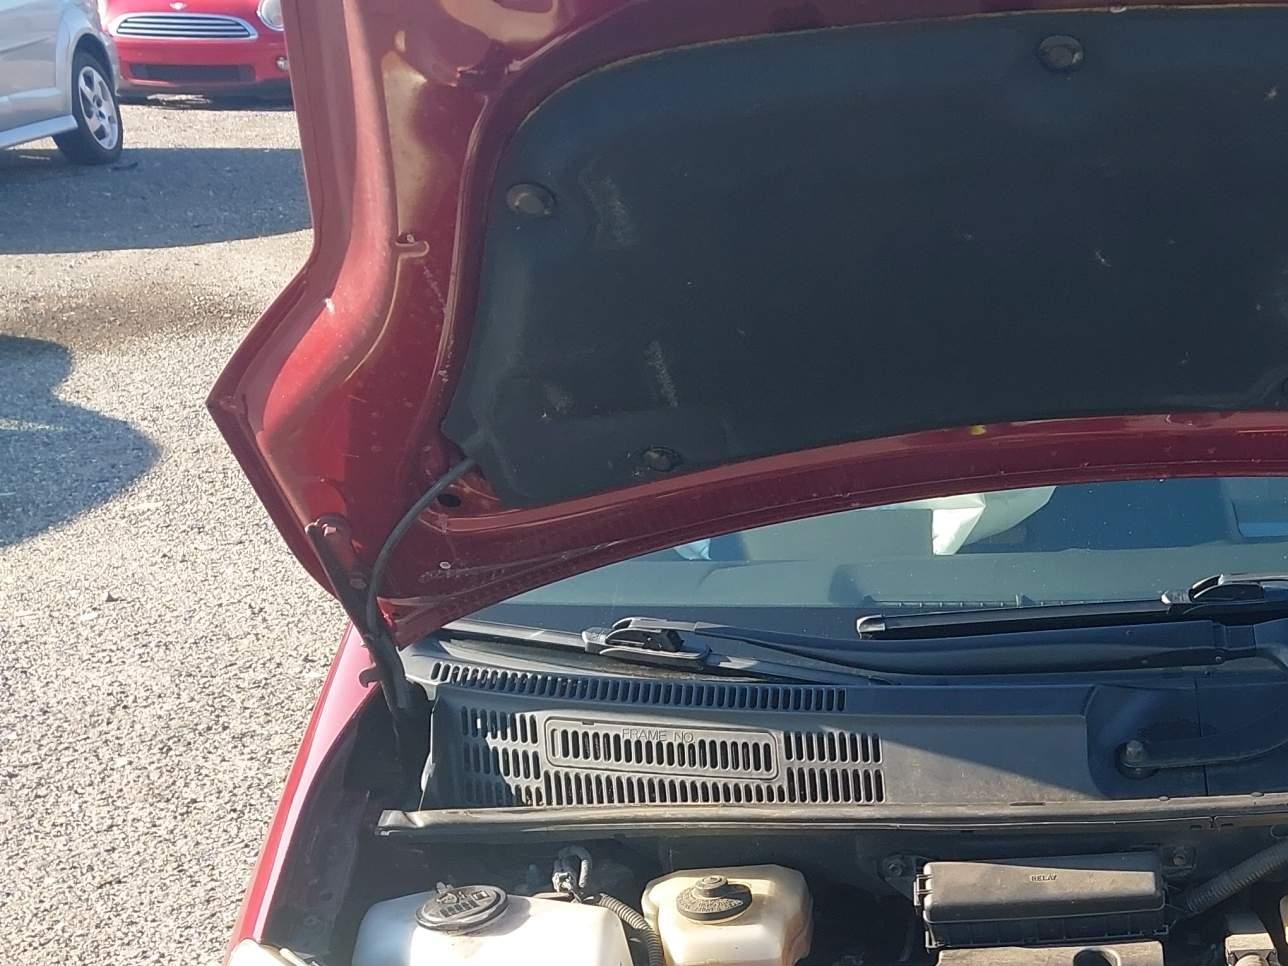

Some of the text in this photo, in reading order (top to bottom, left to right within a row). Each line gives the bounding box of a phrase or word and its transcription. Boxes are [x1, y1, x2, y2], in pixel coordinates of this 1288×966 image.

[622, 728, 696, 744] FRAME NO.
[1031, 874, 1057, 882] RELAY
